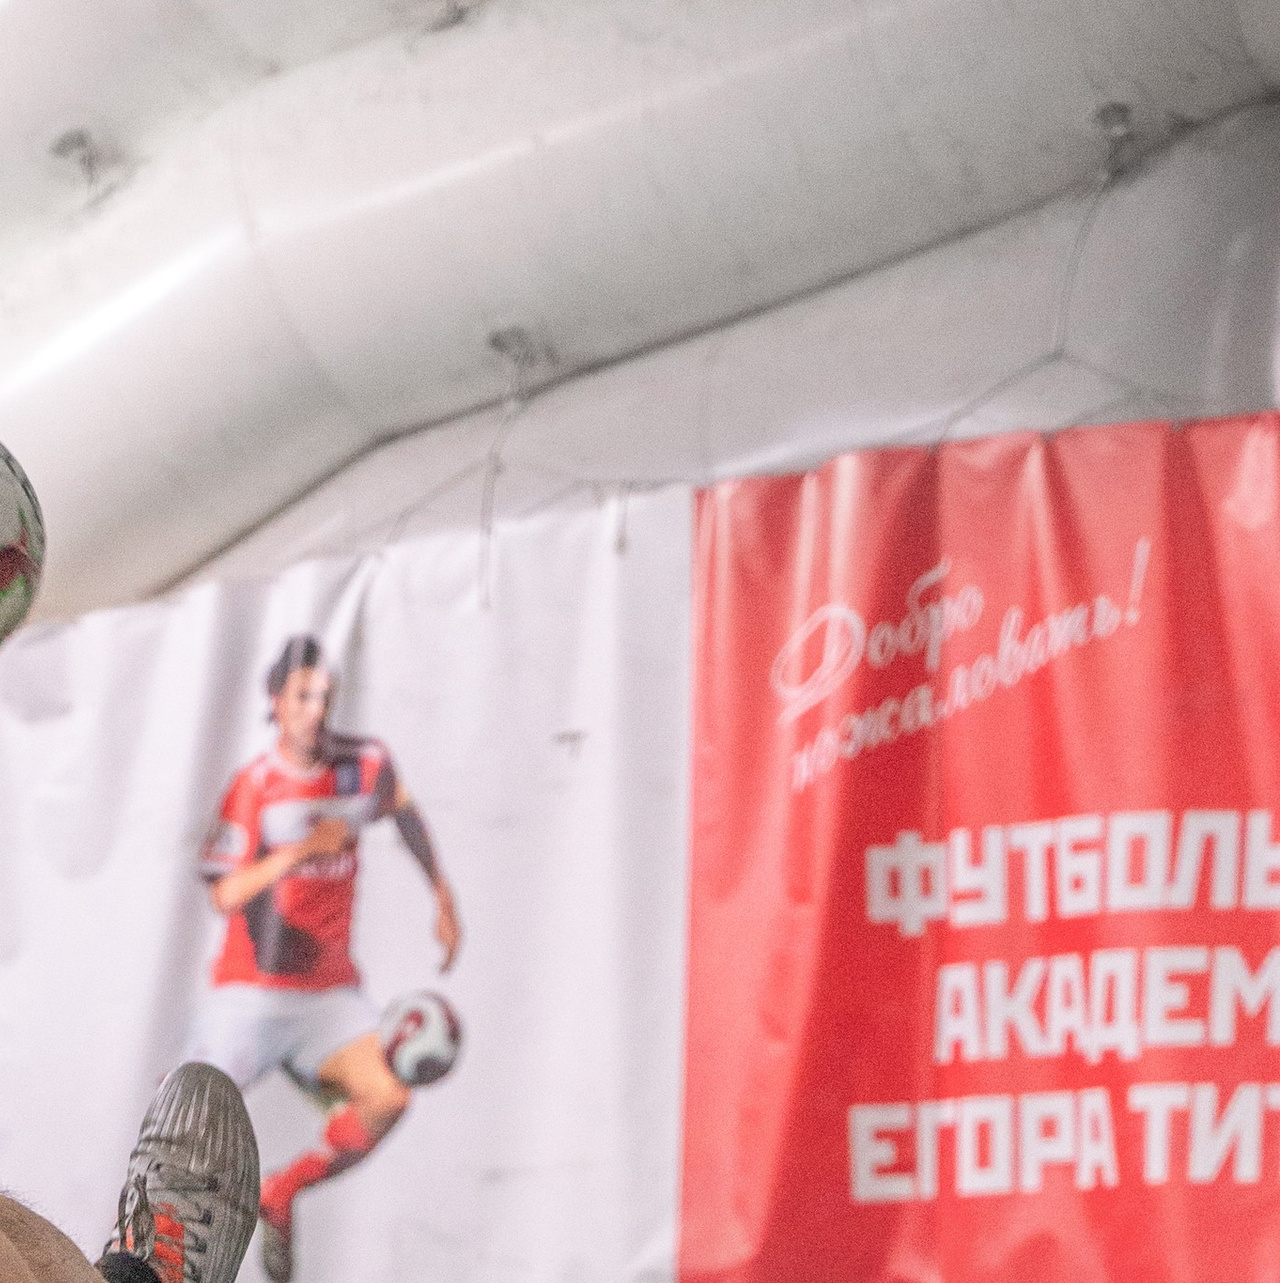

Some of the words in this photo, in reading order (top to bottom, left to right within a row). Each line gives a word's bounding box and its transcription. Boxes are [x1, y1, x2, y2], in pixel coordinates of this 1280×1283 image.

[769, 560, 984, 726] Добро
[935, 946, 1280, 1065] АКАДЕМ
[848, 1087, 1120, 1203] ЕГОРА
[1129, 1082, 1280, 1185] ТИ
